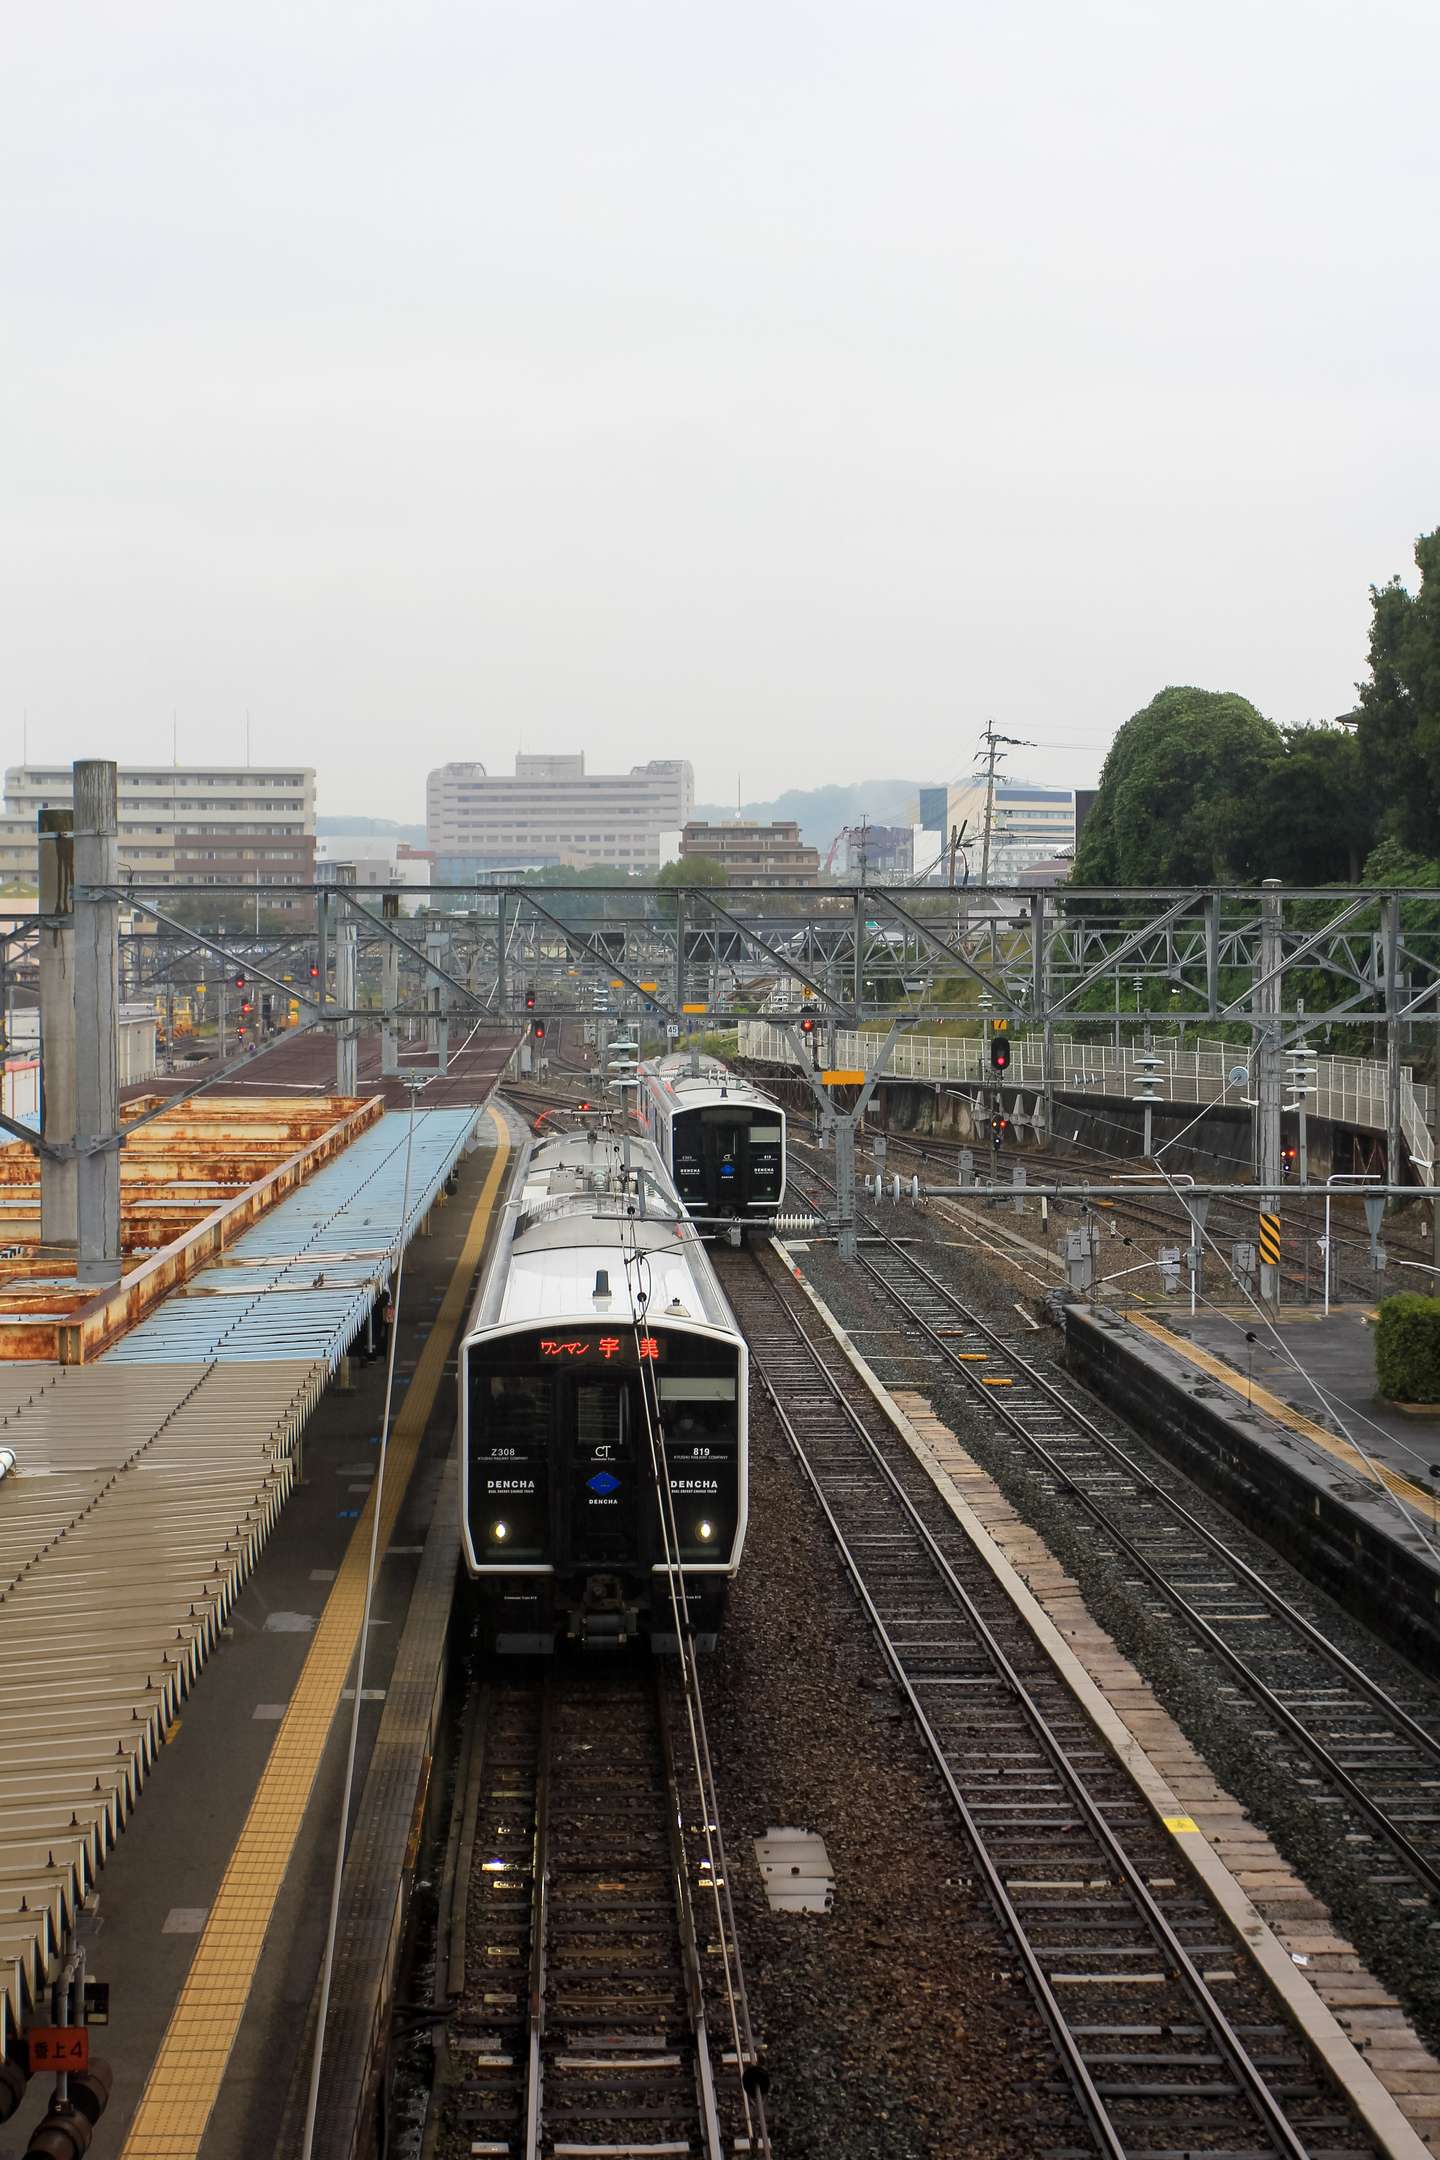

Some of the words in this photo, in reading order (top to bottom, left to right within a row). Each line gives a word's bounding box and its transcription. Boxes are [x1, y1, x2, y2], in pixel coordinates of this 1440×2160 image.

[540, 1341, 589, 1355] ワンマン
[491, 1448, 515, 1456] Z308
[595, 1445, 611, 1458] CT
[693, 1447, 710, 1456] 819
[487, 1480, 535, 1488] DENCHA
[670, 1480, 718, 1488] DENCHA
